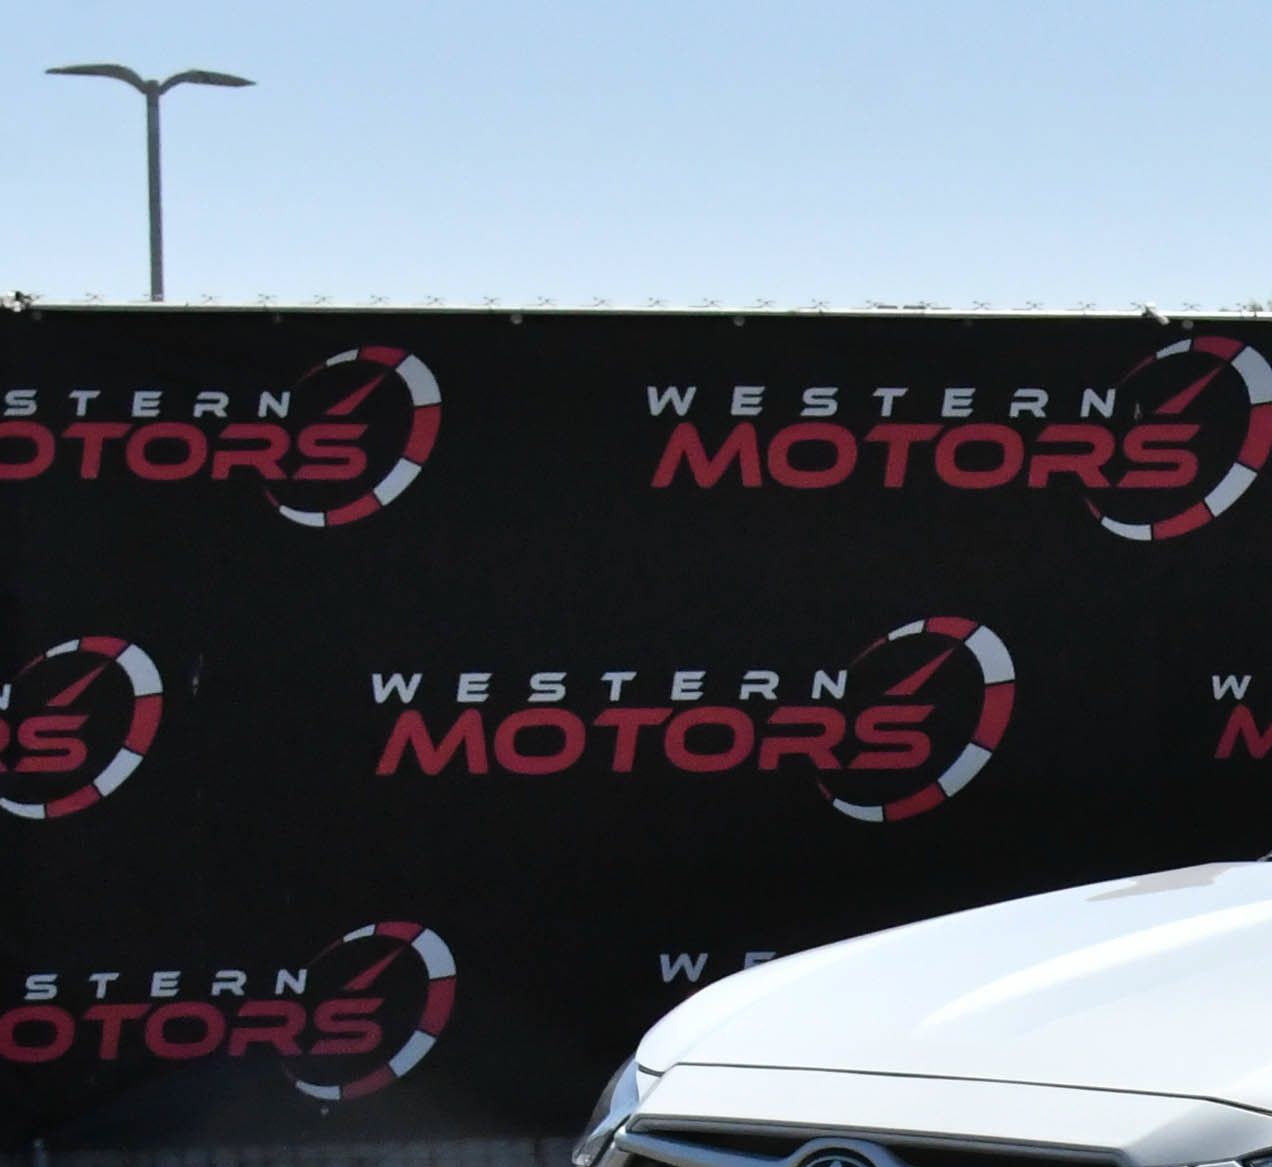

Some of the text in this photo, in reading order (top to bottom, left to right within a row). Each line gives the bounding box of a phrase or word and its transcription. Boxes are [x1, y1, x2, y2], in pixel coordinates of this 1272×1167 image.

[3, 389, 292, 418] STERN
[647, 386, 1116, 418] WESTERN
[0, 420, 368, 481] OTORS
[650, 421, 1200, 489] MOTORS
[371, 669, 848, 704] WESTERN
[375, 704, 935, 776] MOTORS
[24, 967, 309, 1000] STERN
[0, 998, 383, 1063] OTORS
